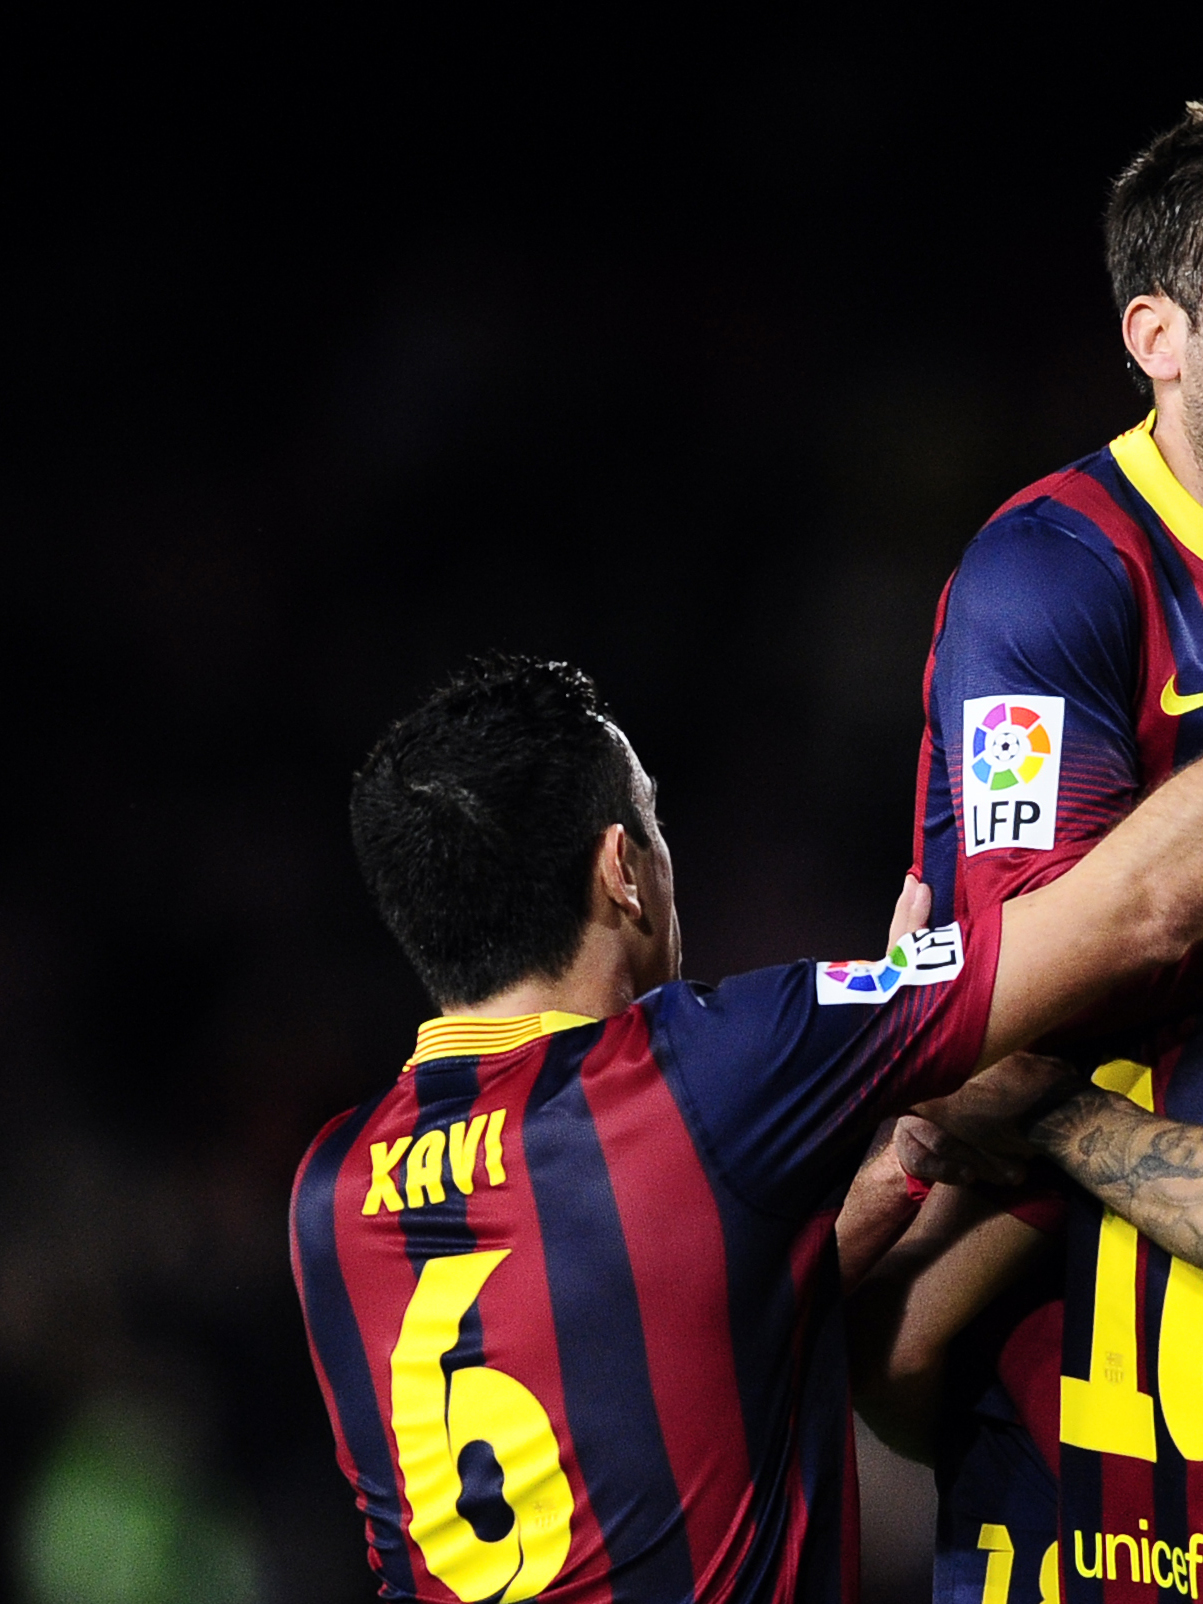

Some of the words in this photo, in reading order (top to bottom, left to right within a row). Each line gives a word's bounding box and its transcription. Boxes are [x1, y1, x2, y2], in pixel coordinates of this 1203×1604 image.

[973, 800, 1041, 847] LFP
[362, 1109, 507, 1216] XAVI
[391, 1248, 576, 1604] 6
